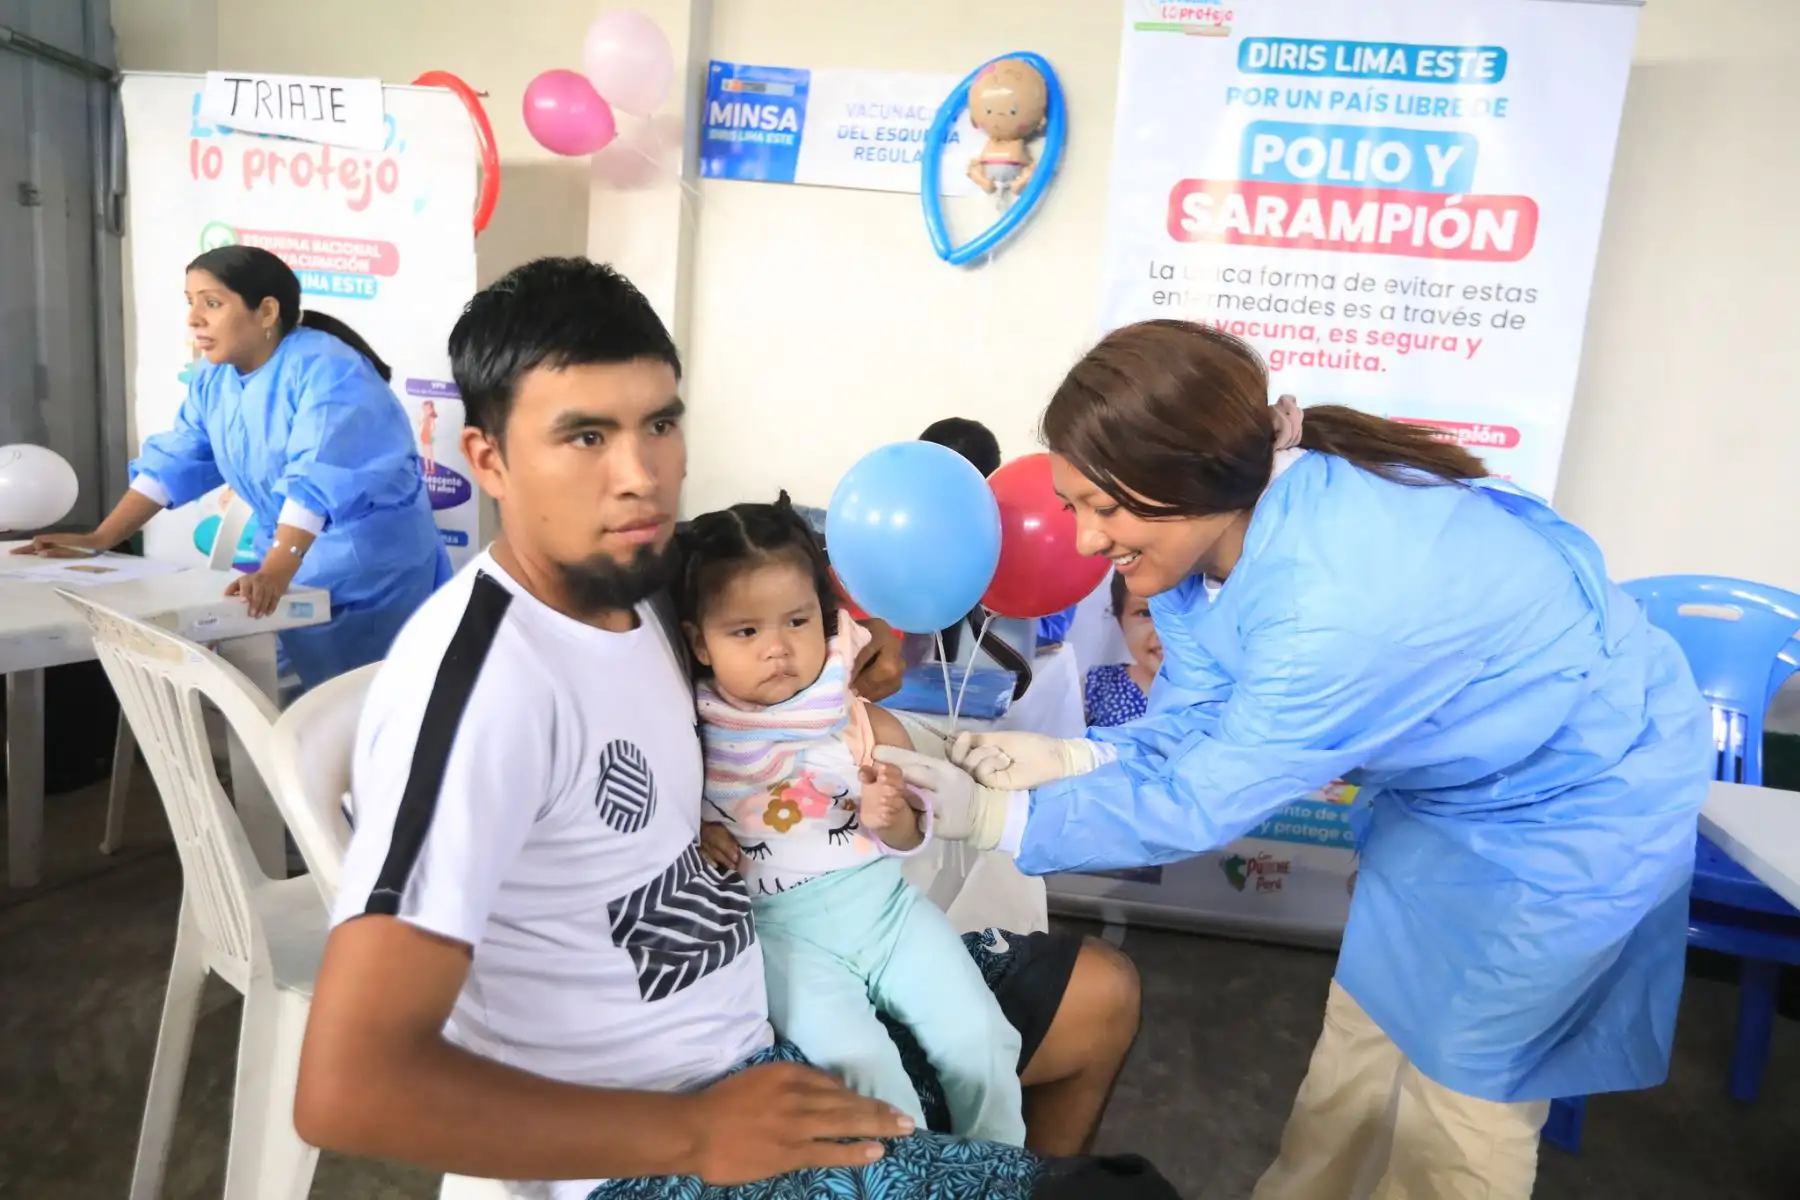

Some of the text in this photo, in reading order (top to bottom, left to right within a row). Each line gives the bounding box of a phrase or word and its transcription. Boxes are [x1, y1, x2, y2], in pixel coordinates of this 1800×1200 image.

[1247, 42, 1499, 79] DIRIS LIMA ESTE
[223, 77, 347, 124] TRIAJE
[846, 102, 929, 122] VACUNAC
[1225, 86, 1280, 108] POR
[1285, 89, 1322, 109] UN
[1329, 86, 1389, 114] PAÍS
[1394, 94, 1463, 117] LIBRE
[709, 101, 798, 132] MINSA
[837, 124, 961, 145] DEL ESQUA
[854, 146, 924, 164] REGULA
[1251, 134, 1464, 187] POLIO Y
[190, 138, 399, 212] lo protejo
[1180, 192, 1519, 252] SARAMPIÓN
[243, 233, 382, 258] ESQUEMA NACIONAL
[301, 274, 375, 295] IMA ESTE
[1149, 260, 1175, 281] La
[1260, 265, 1336, 291] forma
[1343, 272, 1377, 293] de
[1384, 276, 1455, 299] evitar
[1462, 282, 1539, 304] estas
[1343, 302, 1373, 319] es
[1380, 304, 1396, 321] a
[1403, 304, 1482, 328] través
[1490, 310, 1527, 331] de
[1214, 318, 1321, 345] vacuna,
[1329, 327, 1358, 345] es
[1366, 330, 1458, 355] segura
[1466, 337, 1483, 360] y
[1269, 347, 1387, 373] gratuita.
[1315, 807, 1337, 821] de
[1260, 821, 1271, 834] y
[1274, 821, 1340, 842] protege
